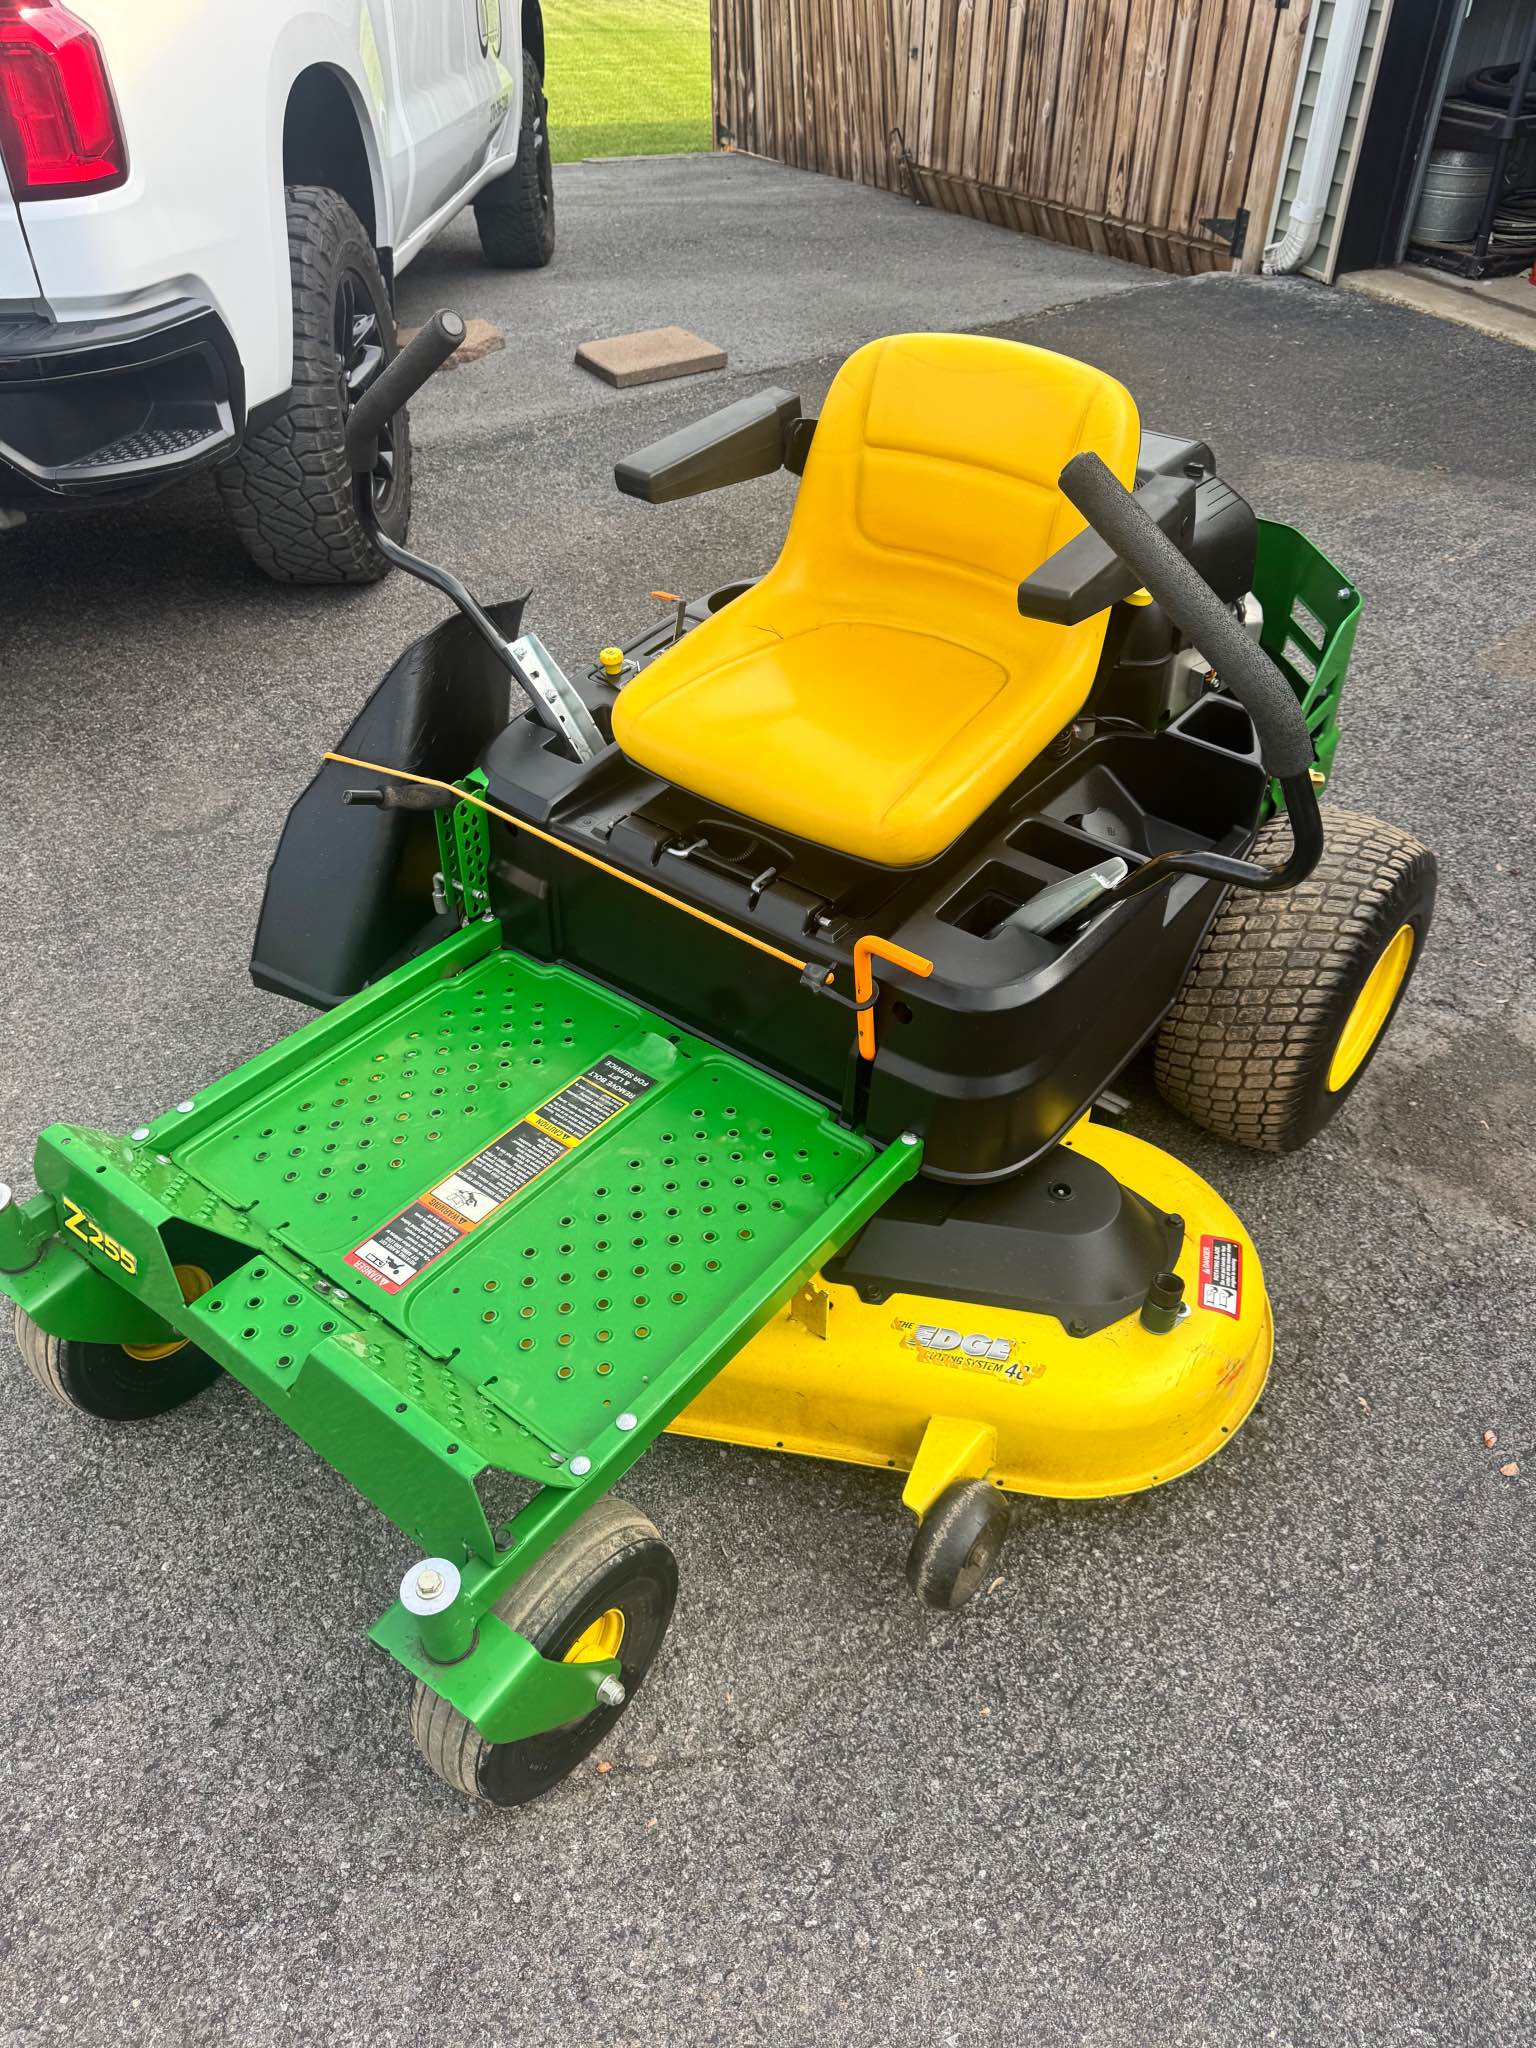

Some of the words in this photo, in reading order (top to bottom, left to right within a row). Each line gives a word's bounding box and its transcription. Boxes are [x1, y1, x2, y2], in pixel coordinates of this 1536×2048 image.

[588, 1070, 607, 1083] BOLT
[604, 1059, 634, 1078] SERVICE
[607, 1071, 624, 1082] LIFT
[605, 1079, 635, 1099] REMOVE
[631, 1075, 649, 1087] FOR
[535, 1117, 563, 1137] CAUTION
[427, 1197, 460, 1221] WARNING
[63, 1195, 136, 1275] Z255
[1202, 1247, 1210, 1268] DANGER
[352, 1259, 383, 1282] DANGER
[899, 1320, 915, 1330] THE
[910, 1324, 1013, 1361] EDGE
[965, 1357, 1004, 1372] SYSTEM
